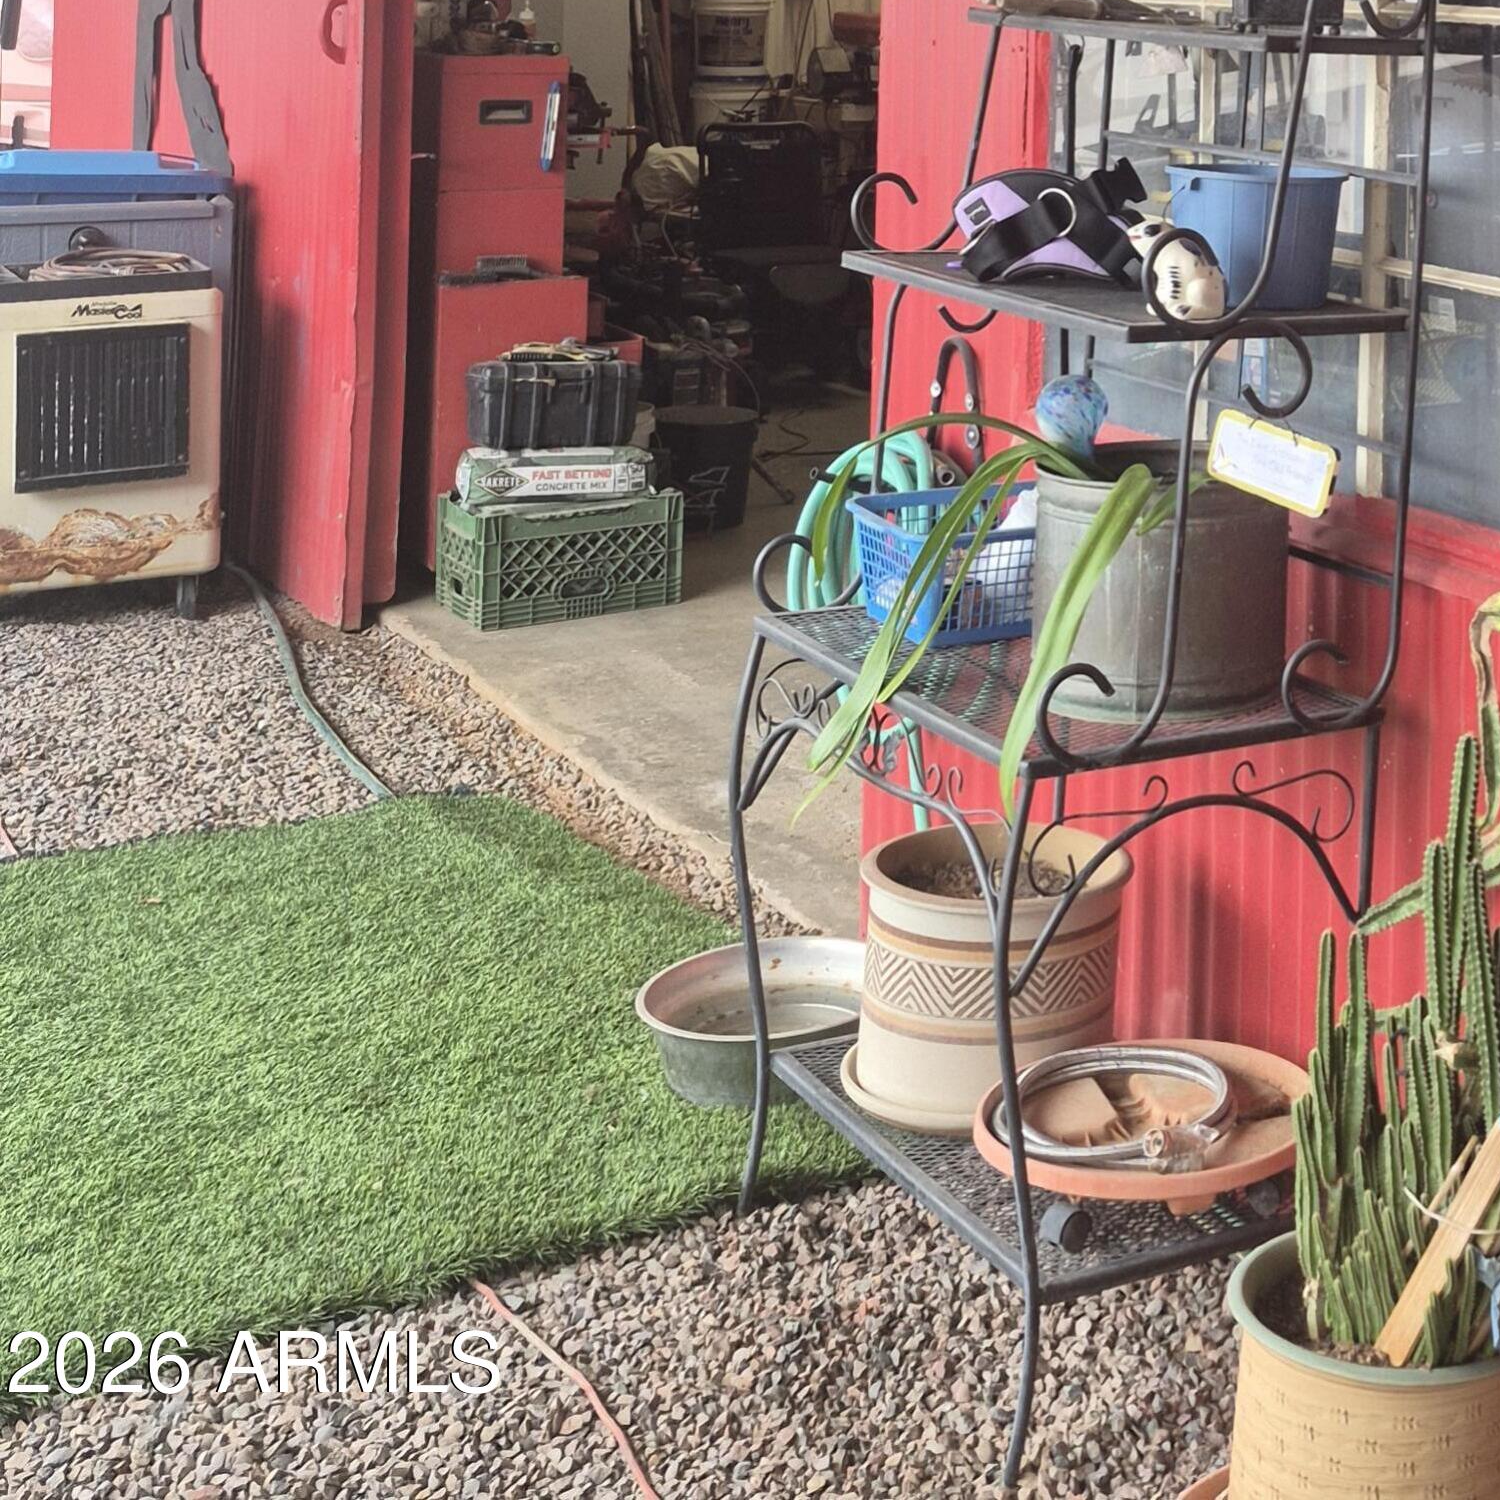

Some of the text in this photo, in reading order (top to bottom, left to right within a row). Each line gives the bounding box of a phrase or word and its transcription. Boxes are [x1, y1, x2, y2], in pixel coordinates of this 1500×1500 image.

[532, 469, 561, 481] FAST
[536, 481, 608, 492] CONCRETE MIX
